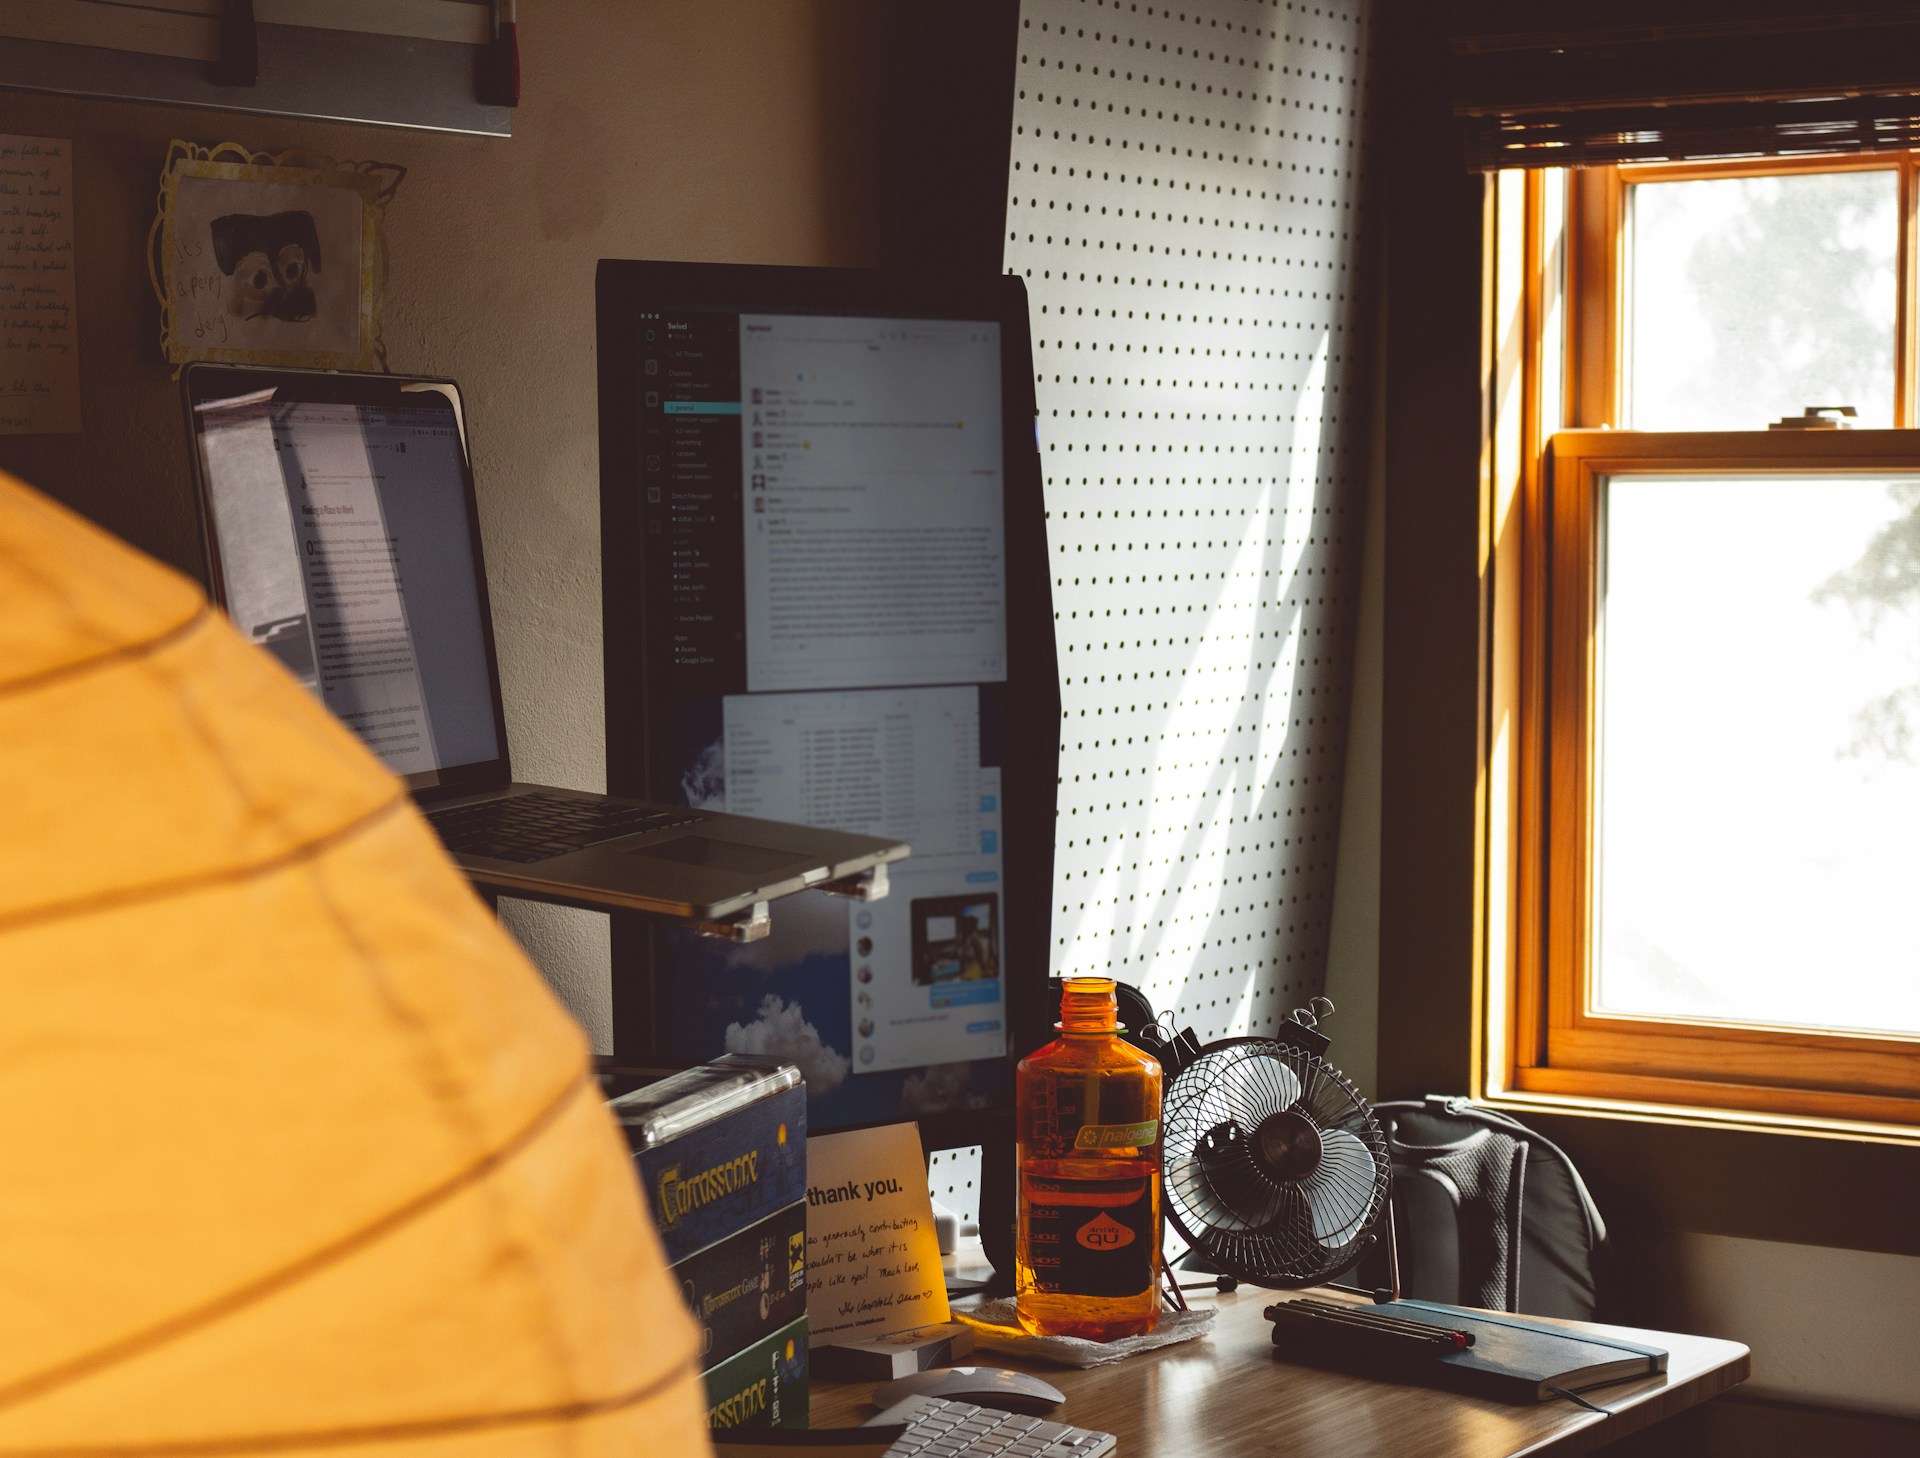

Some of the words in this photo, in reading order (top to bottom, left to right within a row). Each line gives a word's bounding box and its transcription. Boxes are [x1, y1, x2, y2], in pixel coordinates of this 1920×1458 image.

[667, 322, 688, 330] Swivel
[1104, 1126, 1155, 1145] nalgene
[660, 1150, 758, 1224] Carcassonne
[807, 1181, 861, 1207] thank
[864, 1178, 903, 1202] you.
[823, 1225, 866, 1248] generously
[869, 1217, 918, 1233] contributing
[847, 1251, 858, 1262] be
